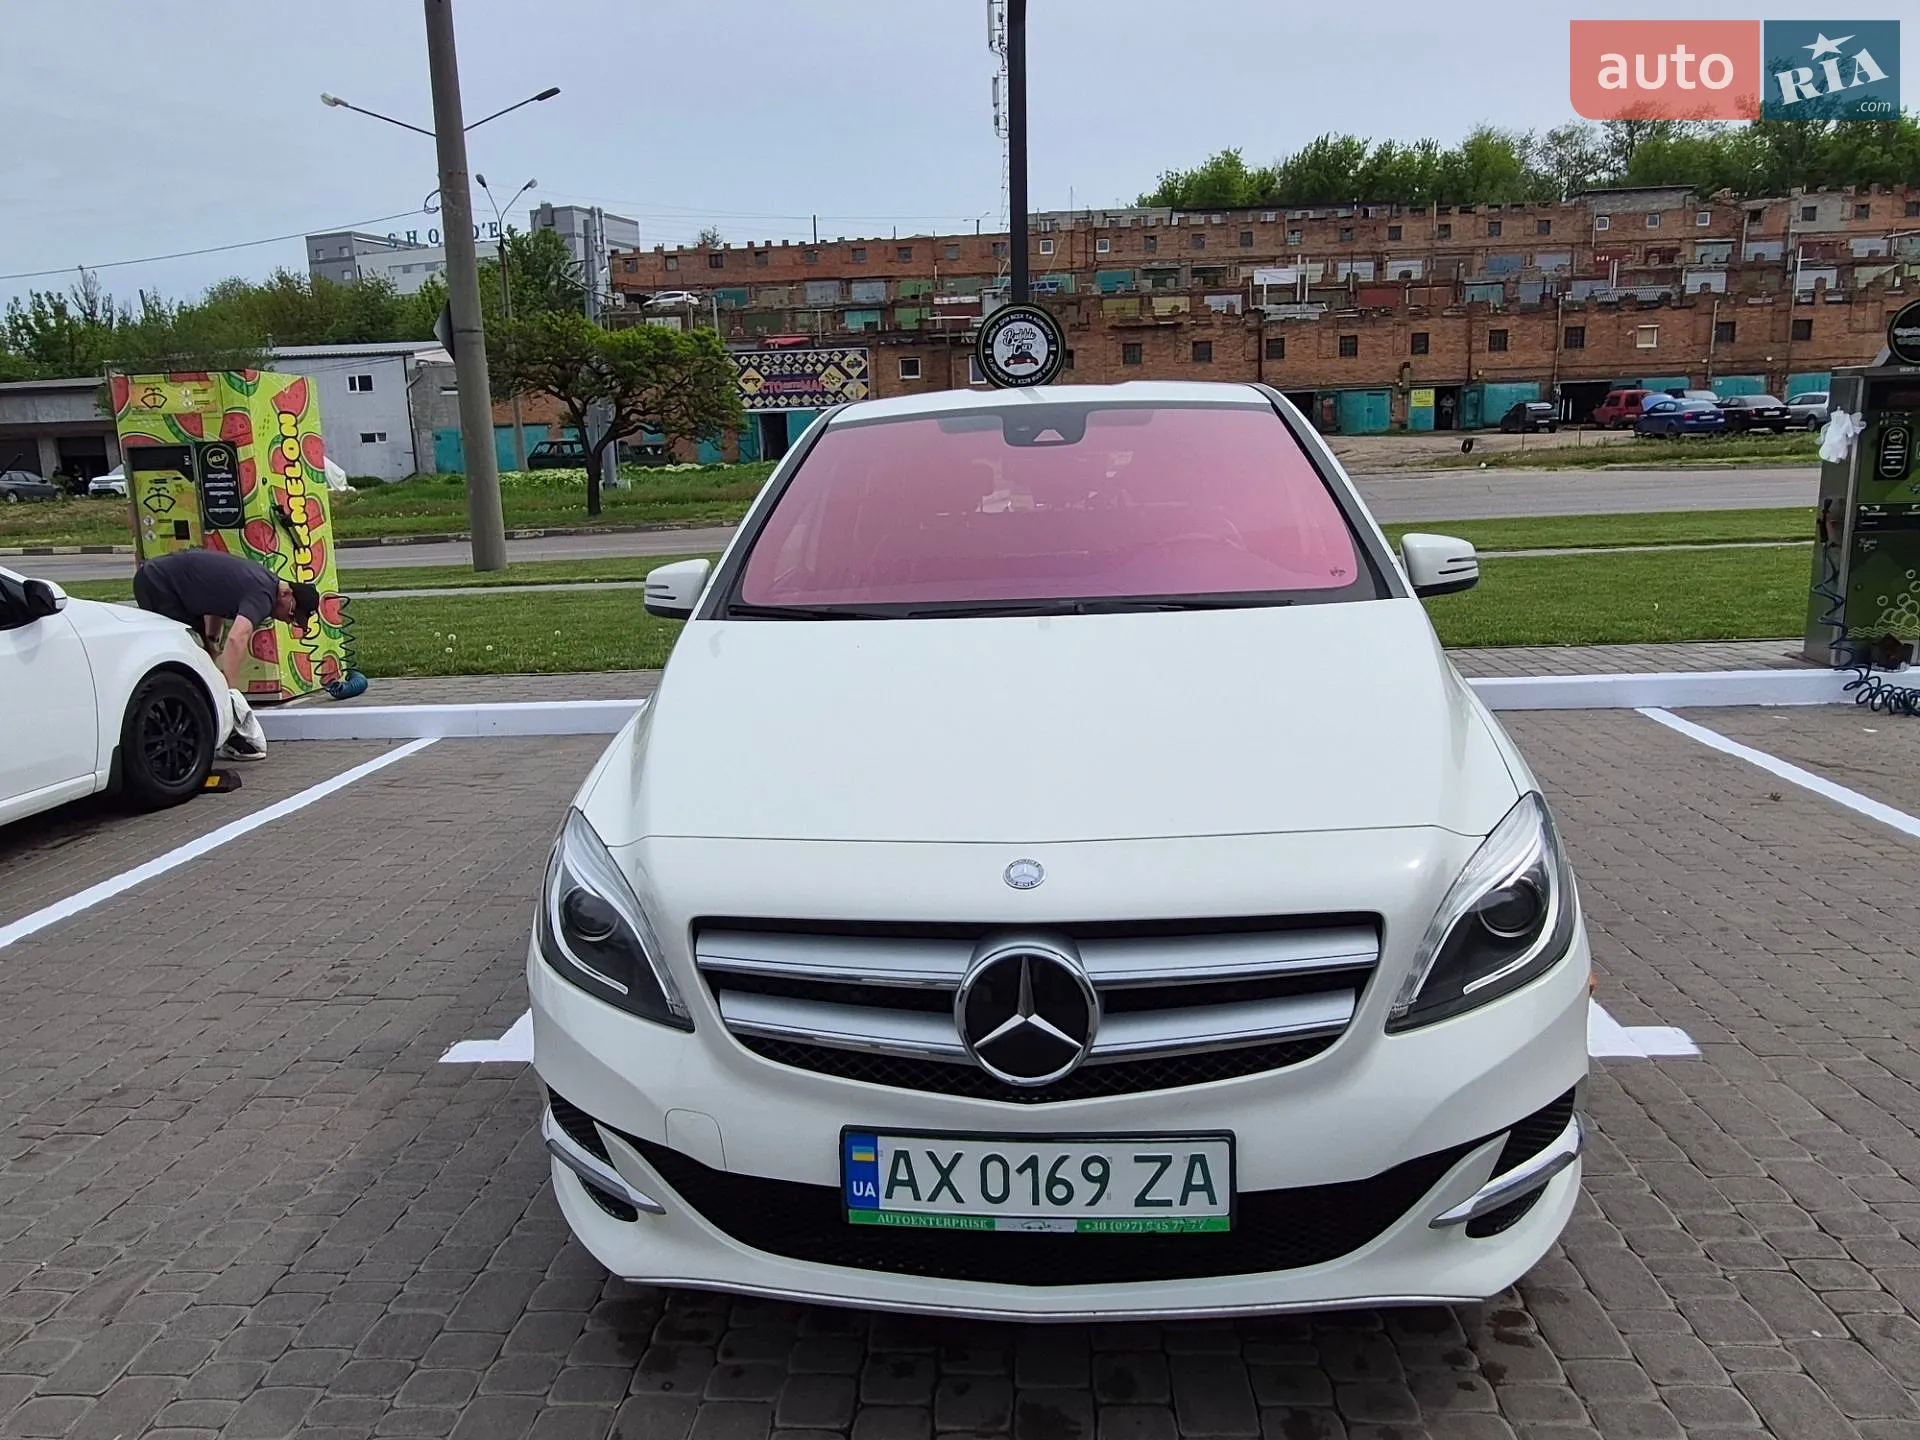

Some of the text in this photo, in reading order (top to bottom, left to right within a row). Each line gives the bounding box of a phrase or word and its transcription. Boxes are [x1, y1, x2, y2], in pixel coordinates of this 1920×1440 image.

[387, 221, 500, 248] SHOD'E
[209, 453, 227, 464] HELP
[884, 1149, 1218, 1208] AX 0169 ZA
[852, 1180, 876, 1198] UA
[877, 1213, 988, 1229] AUTOENTERPRISE
